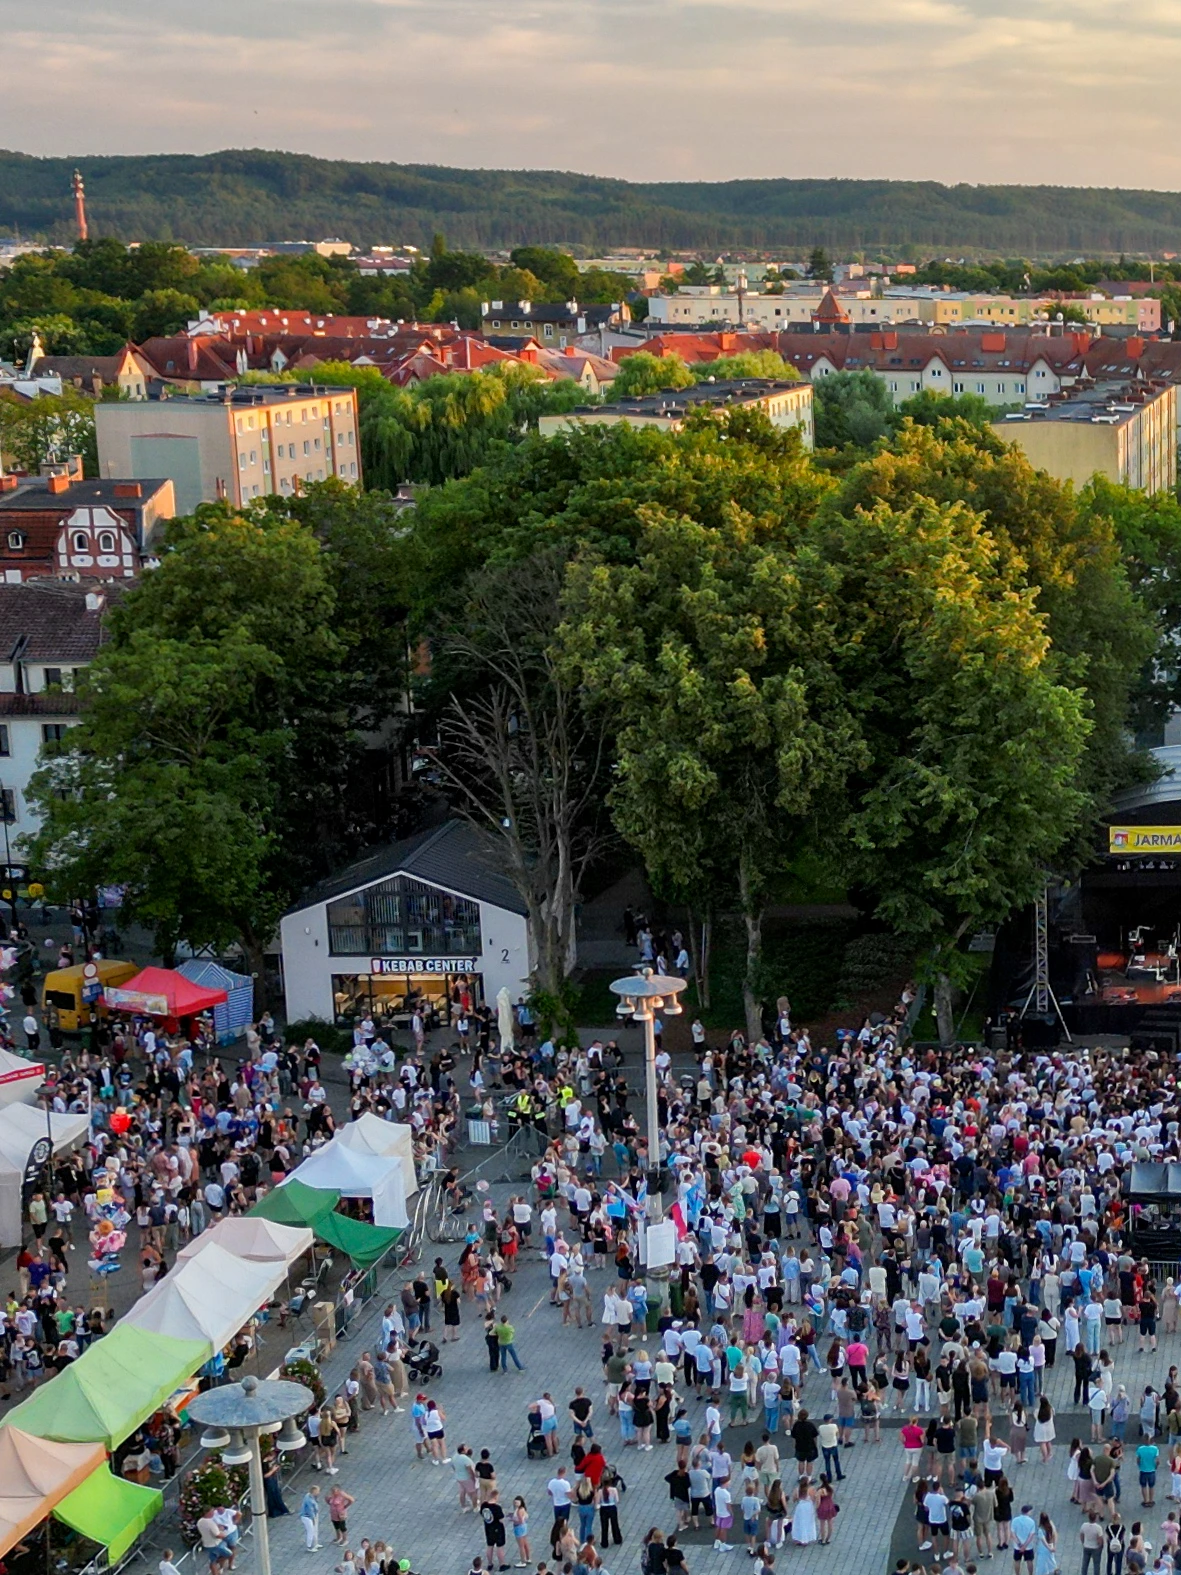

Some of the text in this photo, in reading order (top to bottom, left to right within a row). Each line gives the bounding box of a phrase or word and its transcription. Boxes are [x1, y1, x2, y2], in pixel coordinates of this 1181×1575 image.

[501, 948, 510, 962] 2
[382, 960, 473, 973] KEBAB CENTER
